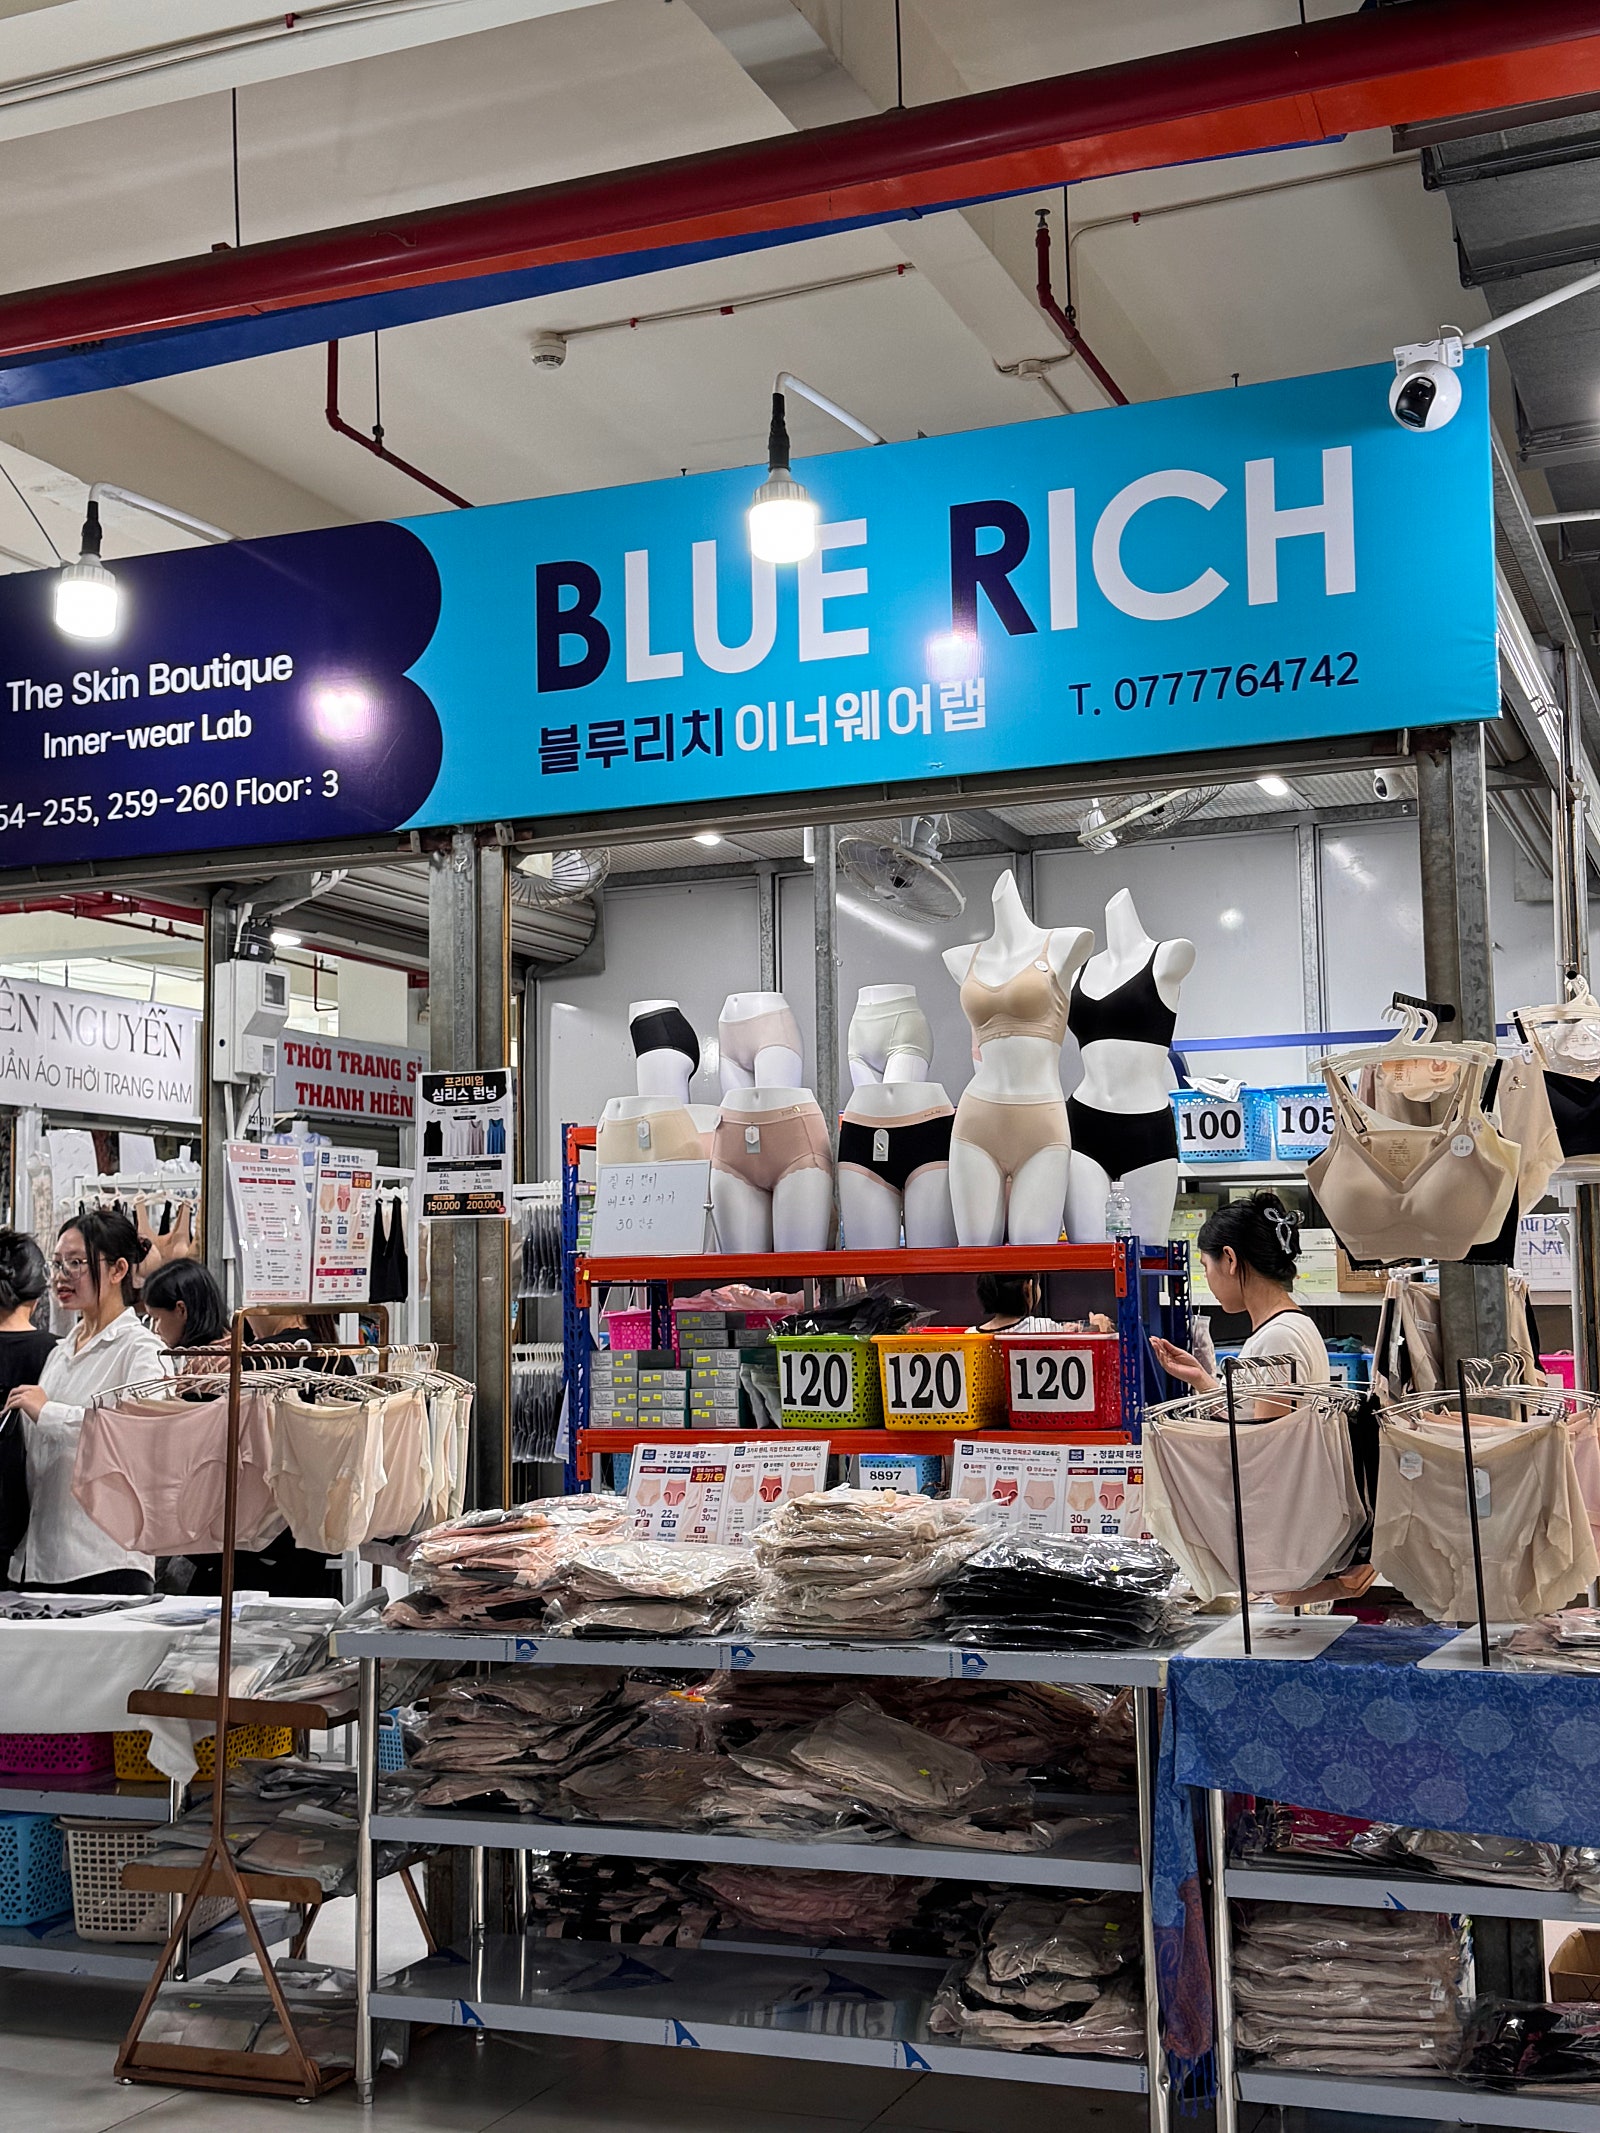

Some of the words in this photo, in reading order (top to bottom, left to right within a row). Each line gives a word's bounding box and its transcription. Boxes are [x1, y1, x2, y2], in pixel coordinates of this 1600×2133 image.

[536, 517, 870, 694] BLUE
[949, 446, 1356, 636] RICH
[6, 679, 63, 712] The
[71, 667, 140, 705] Skin
[149, 652, 294, 697] Boutique
[1068, 683, 1101, 716] T.
[1113, 652, 1359, 711] 0777764742
[43, 721, 196, 759] Inner-wear
[201, 710, 252, 742] Lab
[538, 707, 723, 775] 블루리치
[735, 677, 986, 752] 이너웨어랩
[107, 781, 229, 820] 259-260
[235, 776, 313, 806] Floor:
[321, 770, 340, 798] 3
[51, 1001, 183, 1060] NGUYỄN
[0, 1047, 30, 1080] ẦN
[35, 1055, 61, 1087] ÁO
[66, 1065, 100, 1094] THỜI
[104, 1072, 154, 1100] TRANG
[158, 1080, 192, 1105] NAM
[284, 1041, 332, 1071] THỜI
[338, 1050, 402, 1081] TRANG
[444, 1075, 484, 1087] 프리미엄
[295, 1081, 365, 1112] THANH
[370, 1085, 414, 1118] HIỀN
[432, 1087, 470, 1103] 심리스
[472, 1085, 497, 1100] 런닝
[1182, 1109, 1242, 1140] 100
[1281, 1105, 1336, 1135] 105
[782, 1353, 848, 1408] 120
[888, 1353, 962, 1409] 120
[1015, 1356, 1087, 1400] 120
[869, 1471, 902, 1480] 8897
